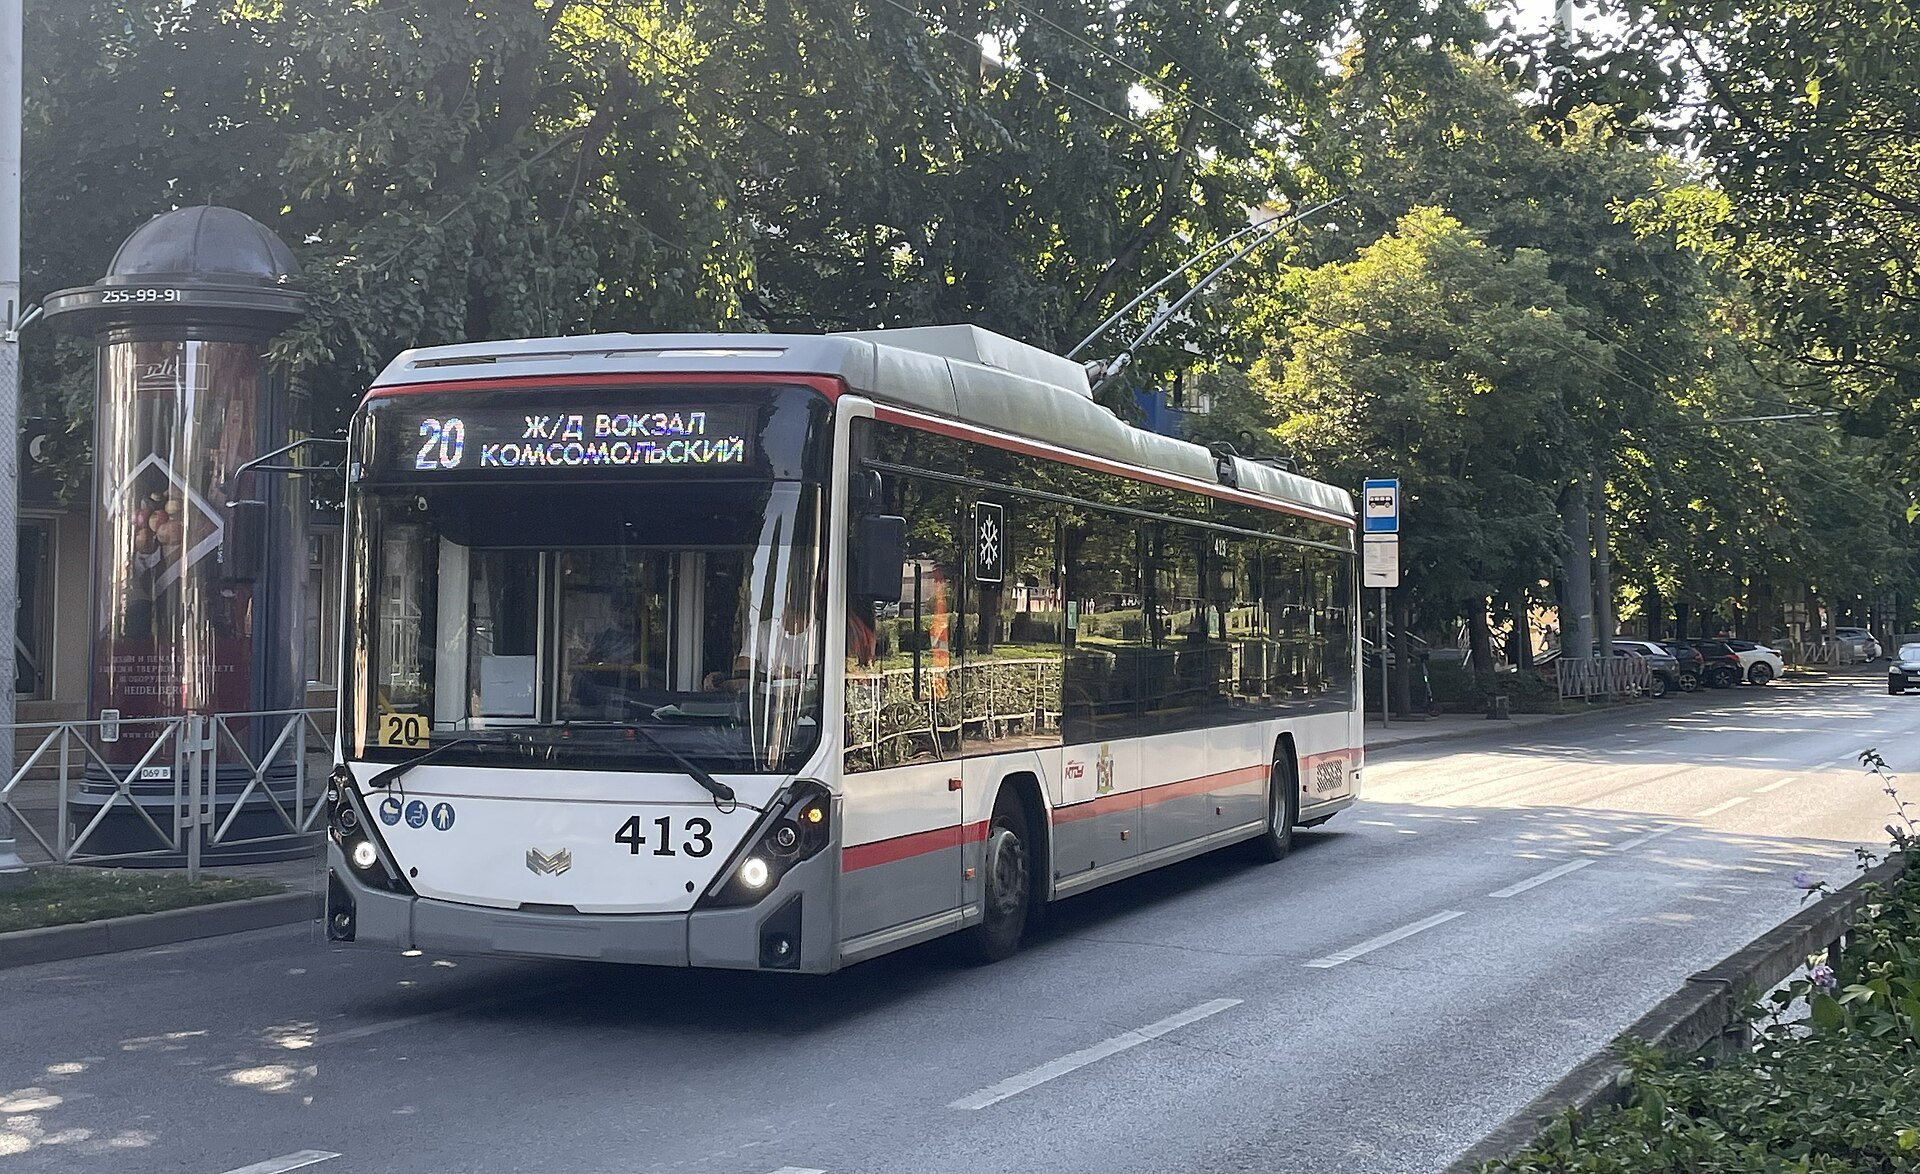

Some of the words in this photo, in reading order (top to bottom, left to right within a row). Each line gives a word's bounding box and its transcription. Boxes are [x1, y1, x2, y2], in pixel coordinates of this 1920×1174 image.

[102, 289, 181, 303] 255-99-91
[521, 413, 583, 441] Ж/Д
[595, 411, 706, 437] ВОКЗАЛ
[415, 418, 465, 469] 20
[480, 435, 745, 467] КОМСОМОЛЬСКИЙ
[388, 716, 420, 746] 20
[614, 815, 713, 858] 413
